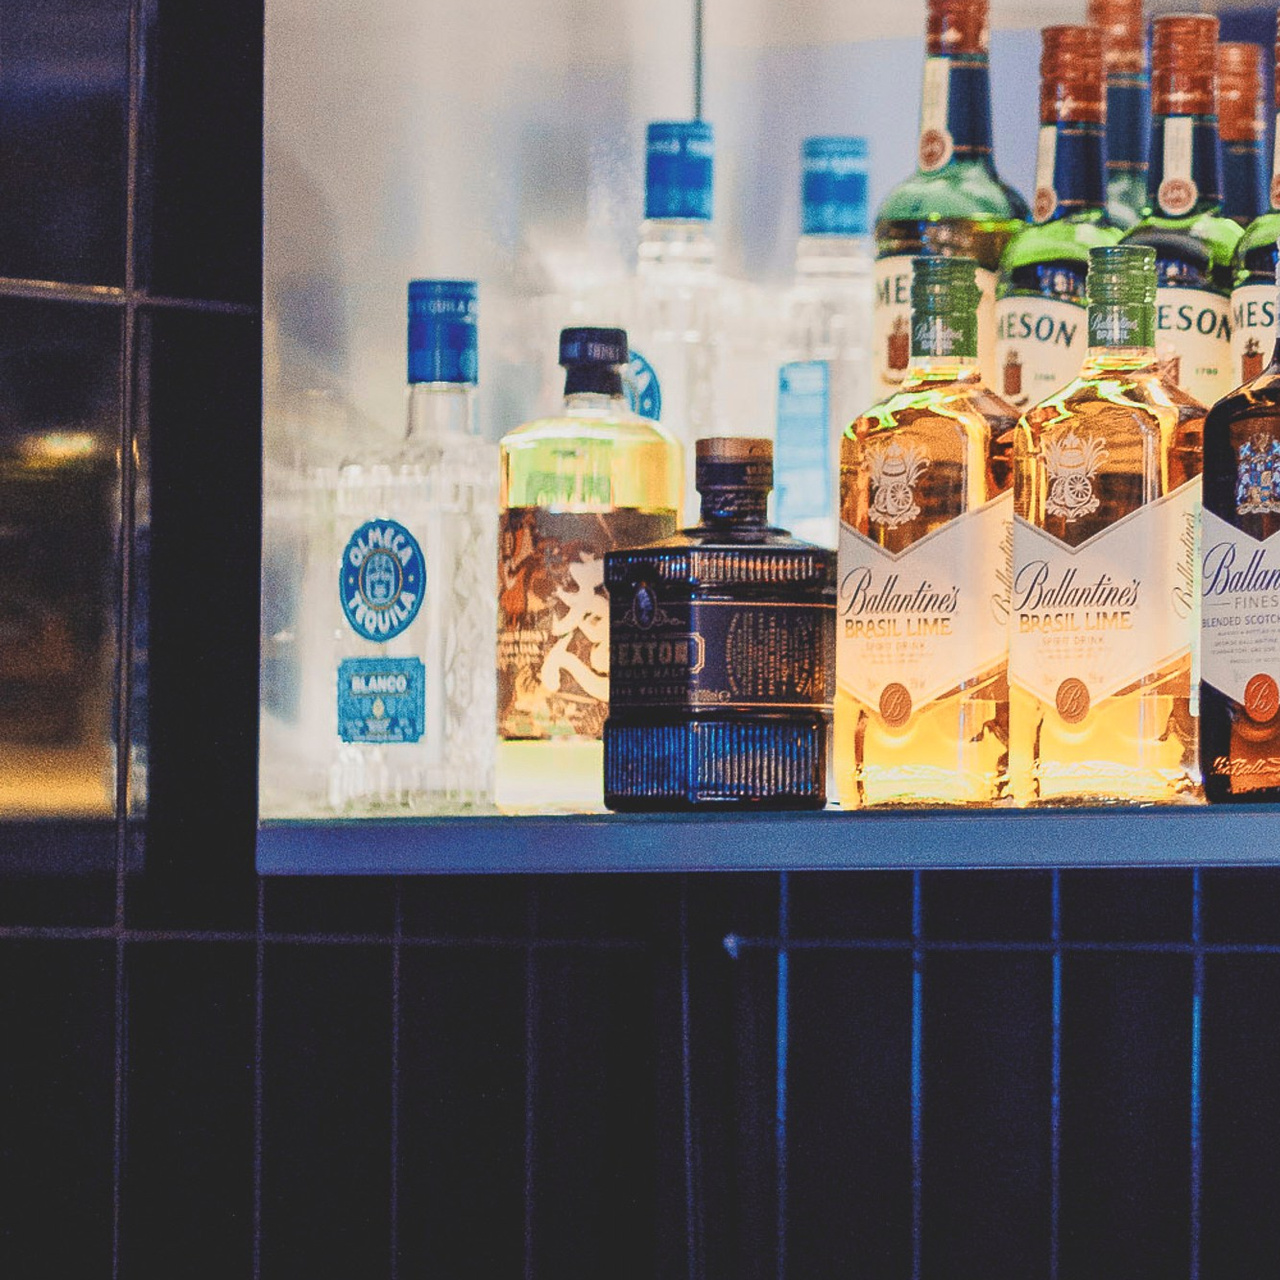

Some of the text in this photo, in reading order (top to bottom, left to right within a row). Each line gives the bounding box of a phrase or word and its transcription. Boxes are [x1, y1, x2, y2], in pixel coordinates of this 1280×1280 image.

[998, 309, 1077, 348] ESON
[1157, 304, 1232, 344] ESON
[349, 526, 414, 568] OLMECA
[838, 566, 961, 617] Ballantine's
[1014, 559, 1141, 612] Ballantine's
[348, 590, 417, 636] TEQUILA
[844, 617, 954, 640] BRASIL LIME
[1018, 611, 1134, 635] BRASIL LIME
[1202, 616, 1241, 628] BLENDED
[351, 673, 408, 695] BLANCO
